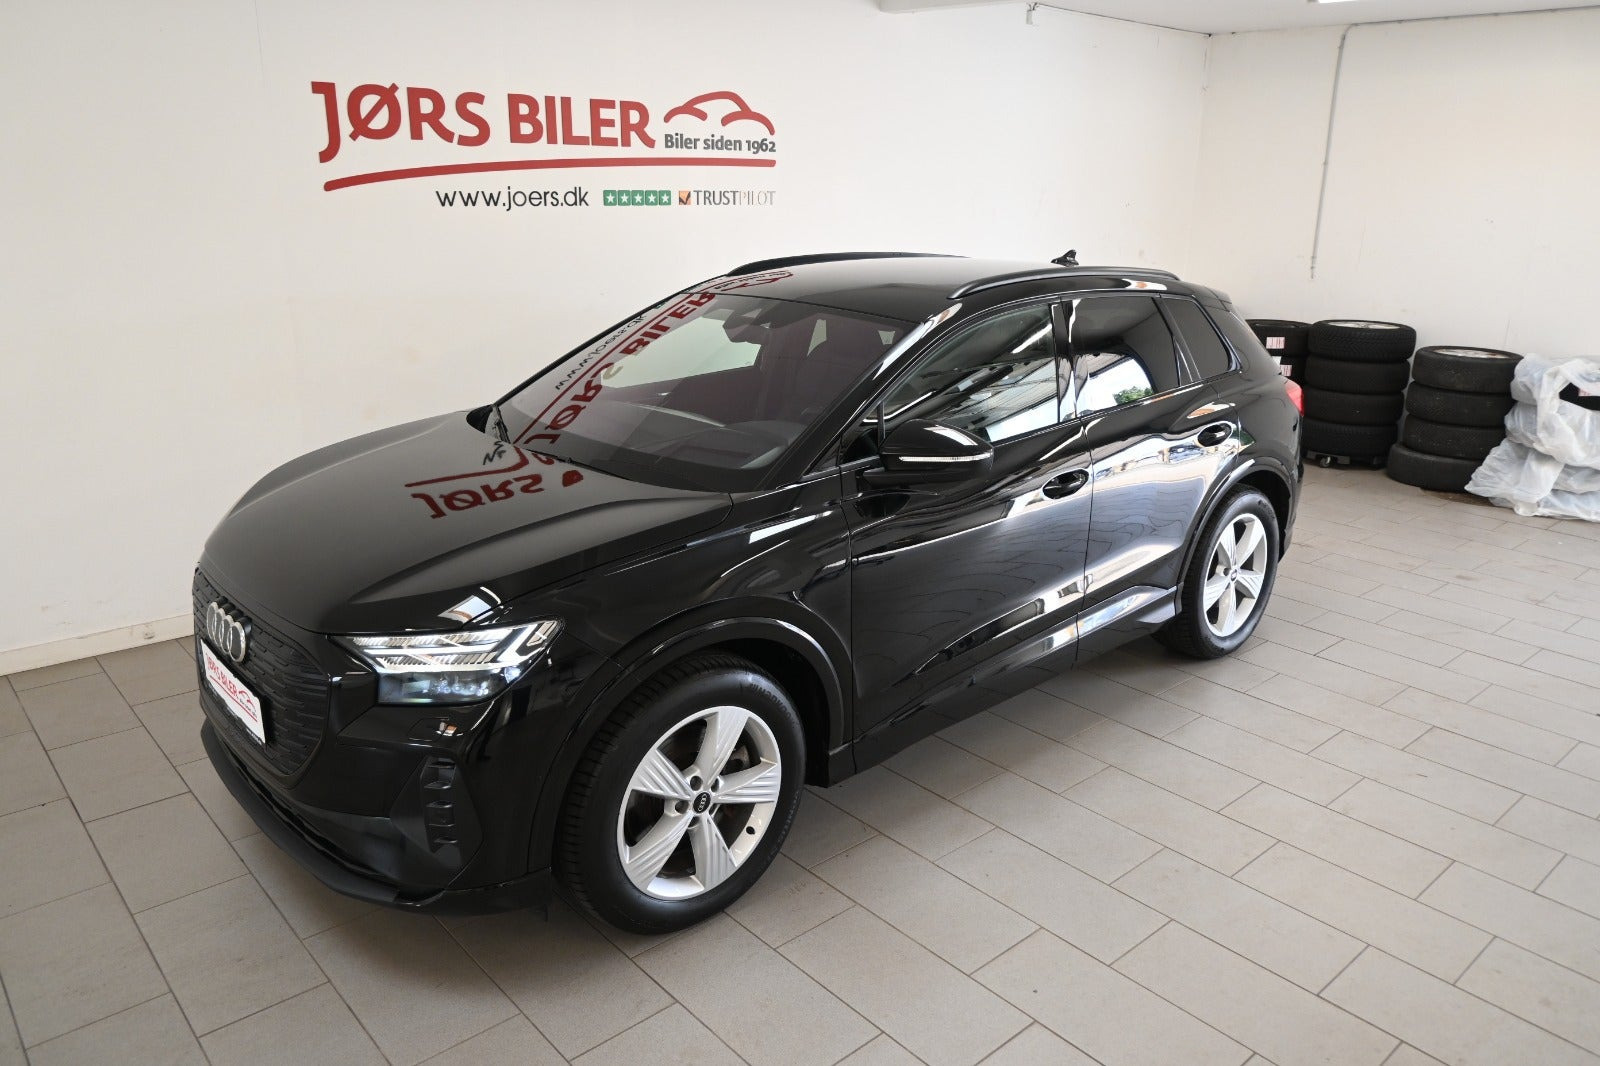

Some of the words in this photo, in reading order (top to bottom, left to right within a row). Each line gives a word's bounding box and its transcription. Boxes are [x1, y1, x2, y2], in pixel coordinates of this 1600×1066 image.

[310, 80, 491, 164] JØRS
[507, 92, 656, 149] BILER
[664, 132, 701, 150] Biler
[703, 134, 743, 152] siden
[745, 137, 777, 155] 1962
[435, 186, 589, 212] www.joers.dk
[692, 189, 776, 206] TRUSTPILOT
